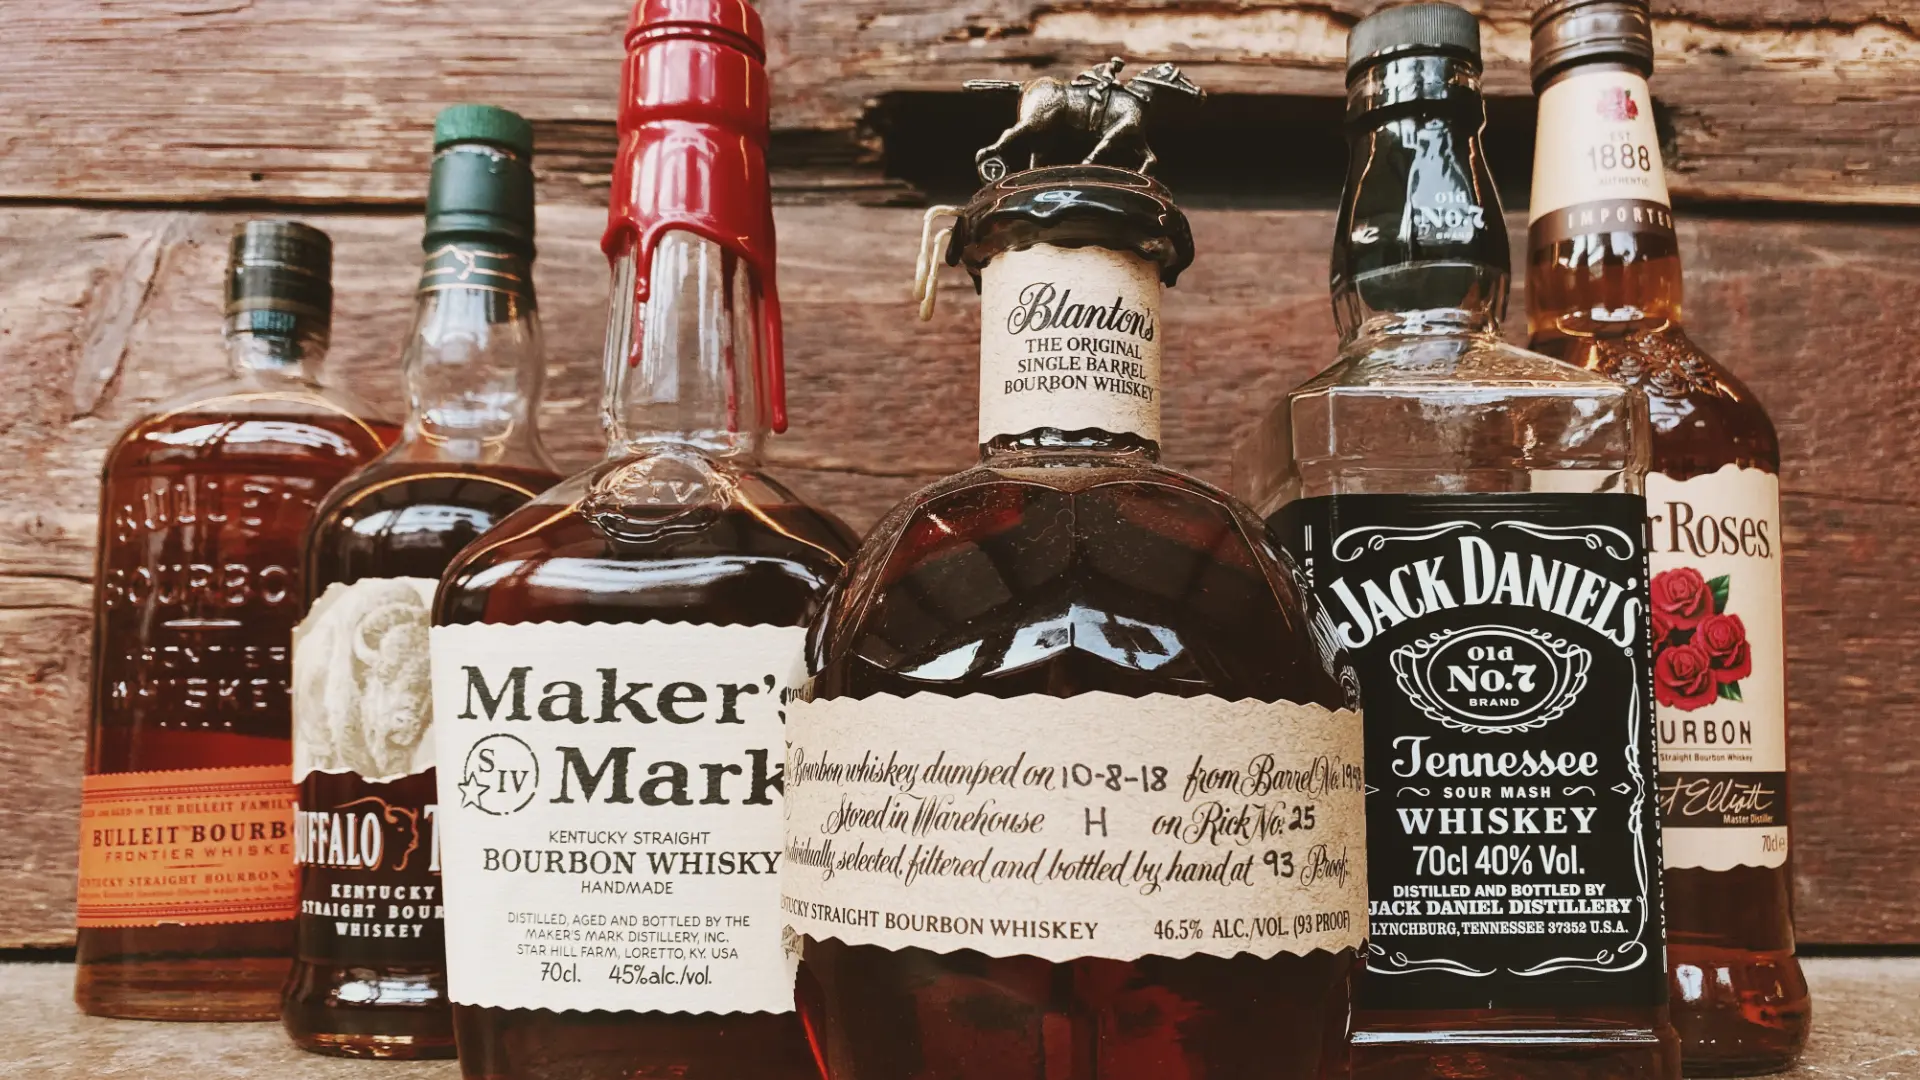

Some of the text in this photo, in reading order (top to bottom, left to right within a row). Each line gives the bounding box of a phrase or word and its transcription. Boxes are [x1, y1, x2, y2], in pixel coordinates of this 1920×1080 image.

[1588, 143, 1651, 172] 1888
[1568, 206, 1672, 229] IMPORTED
[1007, 281, 1154, 342] Blanton's
[1025, 337, 1142, 360] THE ORIGINAL
[1018, 357, 1146, 380] SINGLE BARREL
[1004, 375, 1154, 402] BOURBON WHISKEY
[1664, 501, 1767, 558] Roses
[1446, 664, 1537, 693] No.7
[1469, 698, 1520, 707] BRAND
[1659, 720, 1751, 745] URBON
[1392, 735, 1599, 778] Tennessee
[1694, 753, 1725, 762] Bourbon
[793, 748, 844, 787] Bourbon
[844, 750, 918, 792] whiskey
[921, 750, 1019, 795] dumped
[1022, 764, 1056, 791] on
[1062, 763, 1168, 792] 10-8-18
[1182, 754, 1242, 802] from
[1240, 753, 1317, 796] Barrel
[1443, 786, 1552, 798] SOUR MASH
[821, 793, 892, 835] Stored
[889, 803, 908, 833] in
[896, 793, 1045, 837] Warehouse
[1085, 806, 1108, 838] H
[1152, 815, 1184, 838] on
[1182, 801, 1253, 846] Rick
[1288, 805, 1316, 831] 25
[1396, 807, 1598, 835] WHISKEY
[93, 821, 294, 848] BULLEIT BOURB
[293, 808, 384, 870] UFFALO
[549, 830, 711, 845] KENTUCKY STRAIGHT
[105, 843, 290, 863] FRONTIER WHISKE
[483, 848, 782, 875] BOURBON WHISKY
[785, 836, 836, 882] ndividually
[905, 844, 992, 887] filtered
[991, 848, 1046, 885] and
[1047, 849, 1131, 887] bottled
[1131, 849, 1162, 895] by
[1164, 850, 1232, 887] hand
[1231, 851, 1255, 886] at
[1263, 850, 1294, 878] 93
[1412, 844, 1586, 876] 70cl 40% Vol.
[331, 884, 435, 900] KENTUCKY
[581, 881, 673, 895] HANDMADE
[1393, 883, 1606, 898] DISTILLED AND BOTTLED BY
[302, 900, 445, 919] STRAIGHT BOUR
[1368, 898, 1632, 916] JACK DANIEL DISTILLERY
[335, 922, 423, 938] WHISKEY
[507, 912, 750, 928] DISTILLED, AGED AND BOTTLED BY THE
[811, 903, 880, 928] STRAIGHT
[885, 912, 984, 935] BOURBON
[990, 919, 1099, 940] WHISKEY
[1153, 910, 1350, 940] 46.5% ALC./VOL. (93 PROOF)
[1371, 920, 1629, 937] LYNCHBURG, TENNESSEE 37352 U.S.A.
[525, 929, 730, 945] MAKER'S MARK DISTILLERY, INC.
[517, 944, 738, 961] STAR HILL FARM, LORETTO, KY. USA
[540, 962, 581, 983] 70cl.
